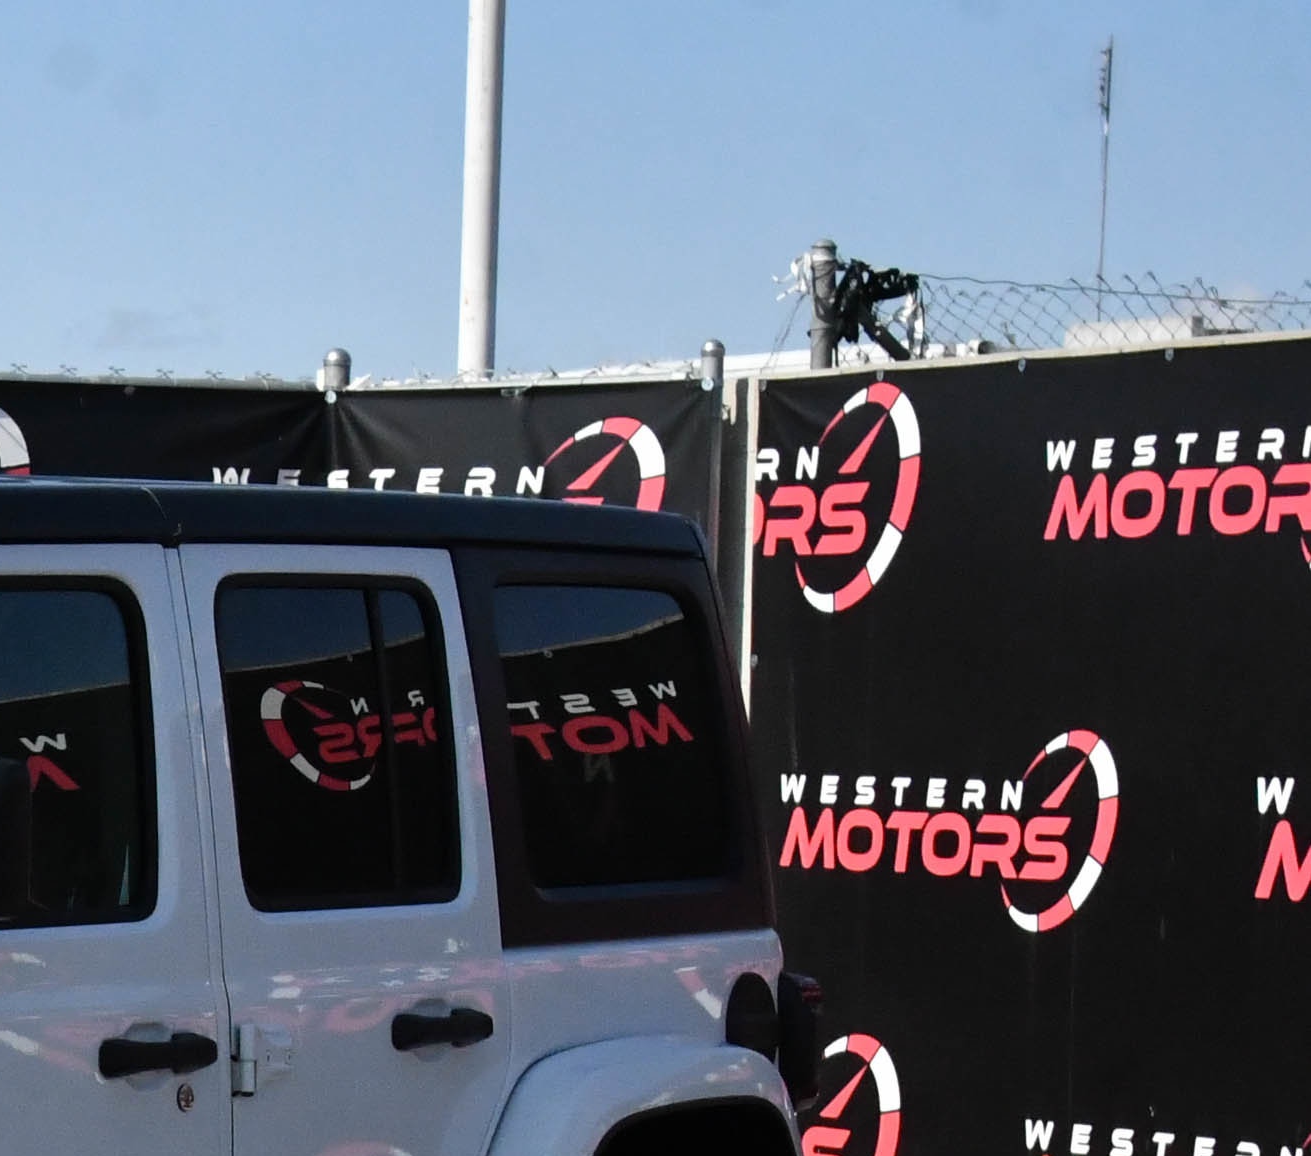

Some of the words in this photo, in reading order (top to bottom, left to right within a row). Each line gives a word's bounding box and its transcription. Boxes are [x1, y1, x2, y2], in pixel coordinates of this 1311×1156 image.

[213, 466, 545, 496] WESTERN
[781, 774, 1023, 811] WESTERN
[779, 805, 1071, 880] MOTORS
